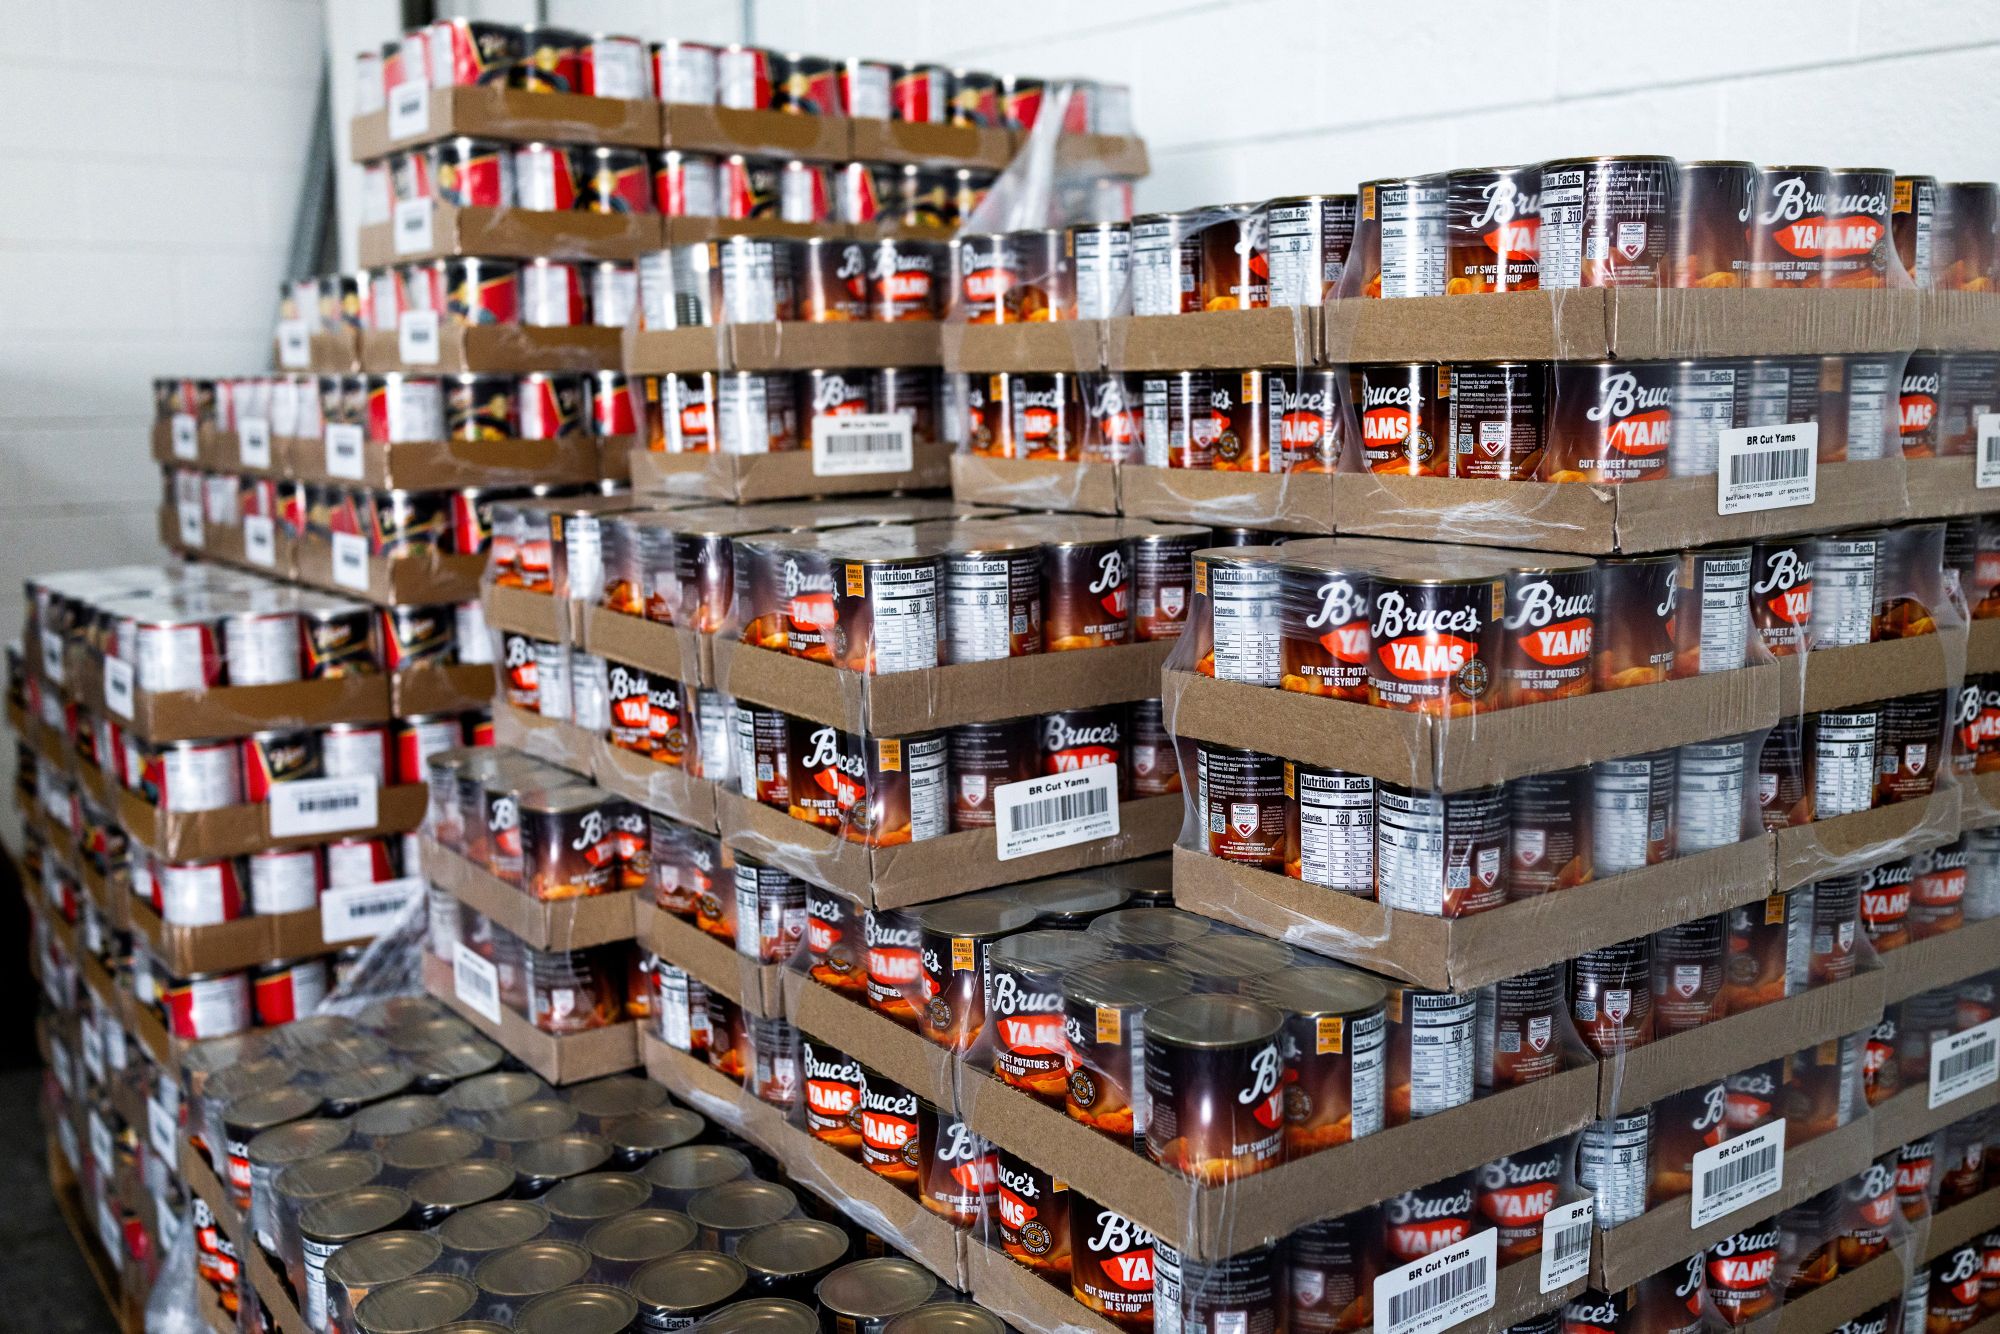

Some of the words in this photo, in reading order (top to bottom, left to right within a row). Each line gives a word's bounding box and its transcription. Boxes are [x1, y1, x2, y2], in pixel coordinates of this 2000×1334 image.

[1558, 173, 1581, 185] Facts
[1550, 212, 1561, 223] 120
[1567, 210, 1581, 222] 310
[1503, 226, 1540, 252] YA
[1465, 265, 1478, 275] CUT
[1486, 275, 1495, 284] IN
[1710, 370, 1732, 382] Facts
[1902, 372, 1939, 394] uce's
[1363, 418, 1409, 440] YAMS
[1746, 435, 1758, 446] BR
[1760, 434, 1774, 445] Cut
[1775, 433, 1796, 443] Yams
[1579, 458, 1594, 469] CUT
[1596, 458, 1626, 469] SWEET
[1628, 458, 1660, 469] POTATOES
[1614, 468, 1641, 478] SYRUP
[1854, 543, 1874, 553] Facts
[982, 562, 1006, 572] Facts
[1705, 562, 1741, 573] Nutrition
[873, 571, 912, 581] Nutrition
[914, 569, 934, 579] Facts
[1213, 569, 1253, 581] Nutrition
[975, 594, 989, 604] 120
[995, 593, 1008, 604] 310
[1704, 598, 1726, 608] Calories
[1735, 594, 1744, 606] 120
[908, 602, 921, 613] 120
[1214, 605, 1236, 615] Calories
[1371, 589, 1483, 639] Bruce's
[1763, 627, 1787, 637] SWEET
[1337, 629, 1369, 654] YA
[1537, 626, 1592, 657] YAMS
[1391, 642, 1464, 672] YAMS
[1650, 654, 1661, 664] CUT
[1301, 665, 1315, 676] CUT
[1316, 665, 1342, 677] SWEET
[1343, 667, 1369, 677] POTA
[1513, 669, 1544, 679] SWEET
[1545, 667, 1581, 679] POTATOES
[1324, 676, 1332, 687] IN
[1333, 676, 1361, 687] SYRUP
[1376, 681, 1397, 694] SWEET
[1398, 683, 1440, 695] POTATOES
[1521, 680, 1531, 689] IN
[1532, 679, 1560, 689] SYRUP
[1386, 692, 1412, 704] SYRUP
[1855, 714, 1874, 725] Facts
[1046, 713, 1119, 751] Bruce's
[910, 741, 940, 754] Nutrition
[1847, 746, 1859, 758] 120
[1622, 763, 1648, 773] Facts
[910, 776, 930, 786] Calories
[1029, 785, 1043, 796] BR
[1045, 782, 1062, 792] Cut
[1064, 777, 1090, 788] Yams
[1301, 774, 1340, 789] Nutrition
[1344, 778, 1370, 790] Facts
[812, 799, 836, 809] SWEET
[1301, 811, 1323, 823] Calories
[1335, 813, 1350, 825] 120
[1358, 813, 1373, 825] 310
[1414, 995, 1456, 1009] Nutrition
[1413, 1033, 1439, 1044] Calories
[1451, 1028, 1463, 1041] 120
[803, 1042, 861, 1083] Bruce's
[1013, 1057, 1050, 1070] POTATOES
[1353, 1058, 1374, 1070] Calories
[1005, 1064, 1026, 1077] SYRUP
[807, 1082, 853, 1111] YAMS
[860, 1071, 918, 1116] Bruce's
[1628, 1118, 1648, 1129] Facts
[863, 1116, 908, 1146] YAMS
[1232, 1143, 1249, 1156] CUT
[1719, 1149, 1730, 1160] BR
[1731, 1144, 1744, 1155] Cut
[1745, 1135, 1765, 1148] Yams
[1619, 1151, 1632, 1163] 120
[1000, 1164, 1040, 1197] uce's
[935, 1191, 948, 1201] CUT
[1492, 1190, 1553, 1218] YAMS
[1571, 1207, 1584, 1220] BR
[1396, 1225, 1463, 1254] YAMS
[1117, 1257, 1154, 1282] YA
[1408, 1267, 1423, 1281] BR
[1425, 1259, 1442, 1274] Cut
[1443, 1248, 1470, 1266] Yams
[1723, 1256, 1775, 1282] YAMS
[1084, 1283, 1098, 1296] CUT
[1098, 1289, 1126, 1303] SWEET
[1104, 1300, 1114, 1310] IN
[1115, 1302, 1142, 1313] SYRUP
[666, 1317, 691, 1329] Facts
